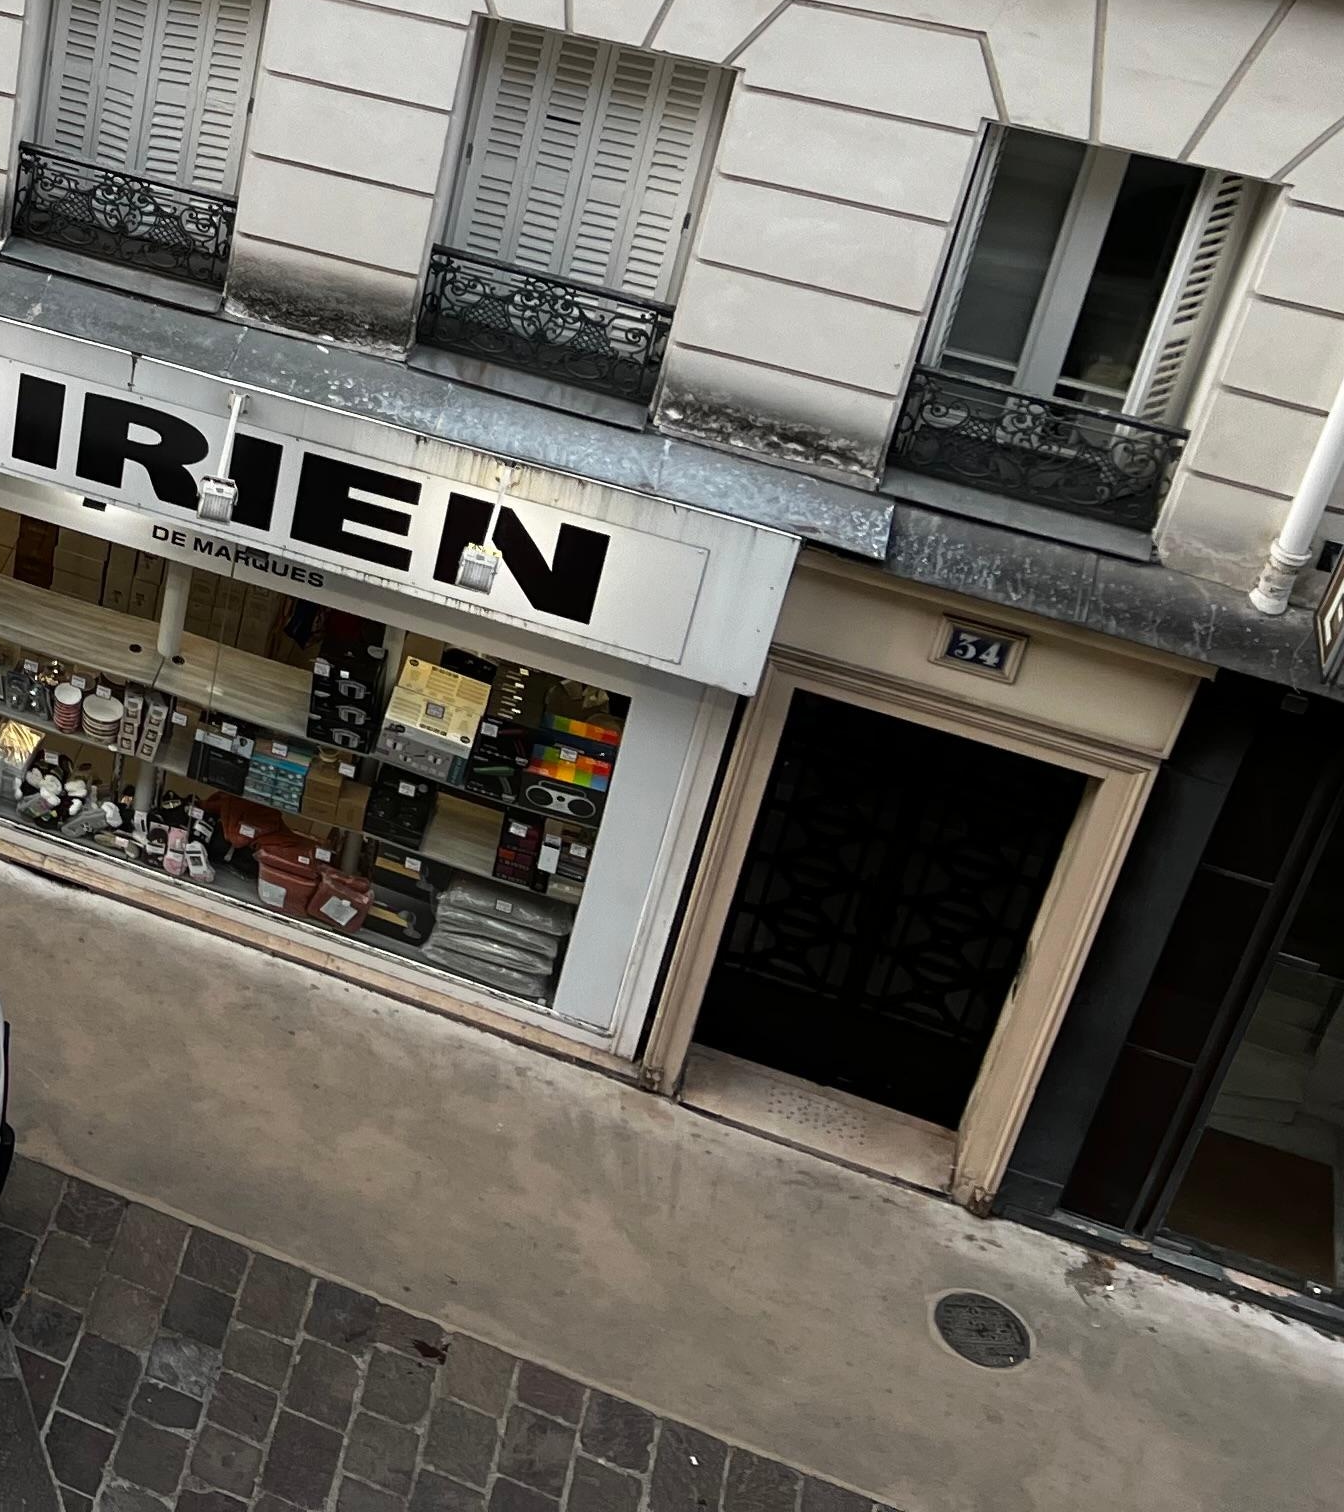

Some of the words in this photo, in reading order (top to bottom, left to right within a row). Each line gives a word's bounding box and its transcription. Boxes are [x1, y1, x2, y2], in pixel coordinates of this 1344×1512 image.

[151, 524, 188, 549] DE
[192, 536, 325, 589] MARQUES
[950, 632, 1004, 669] 34
